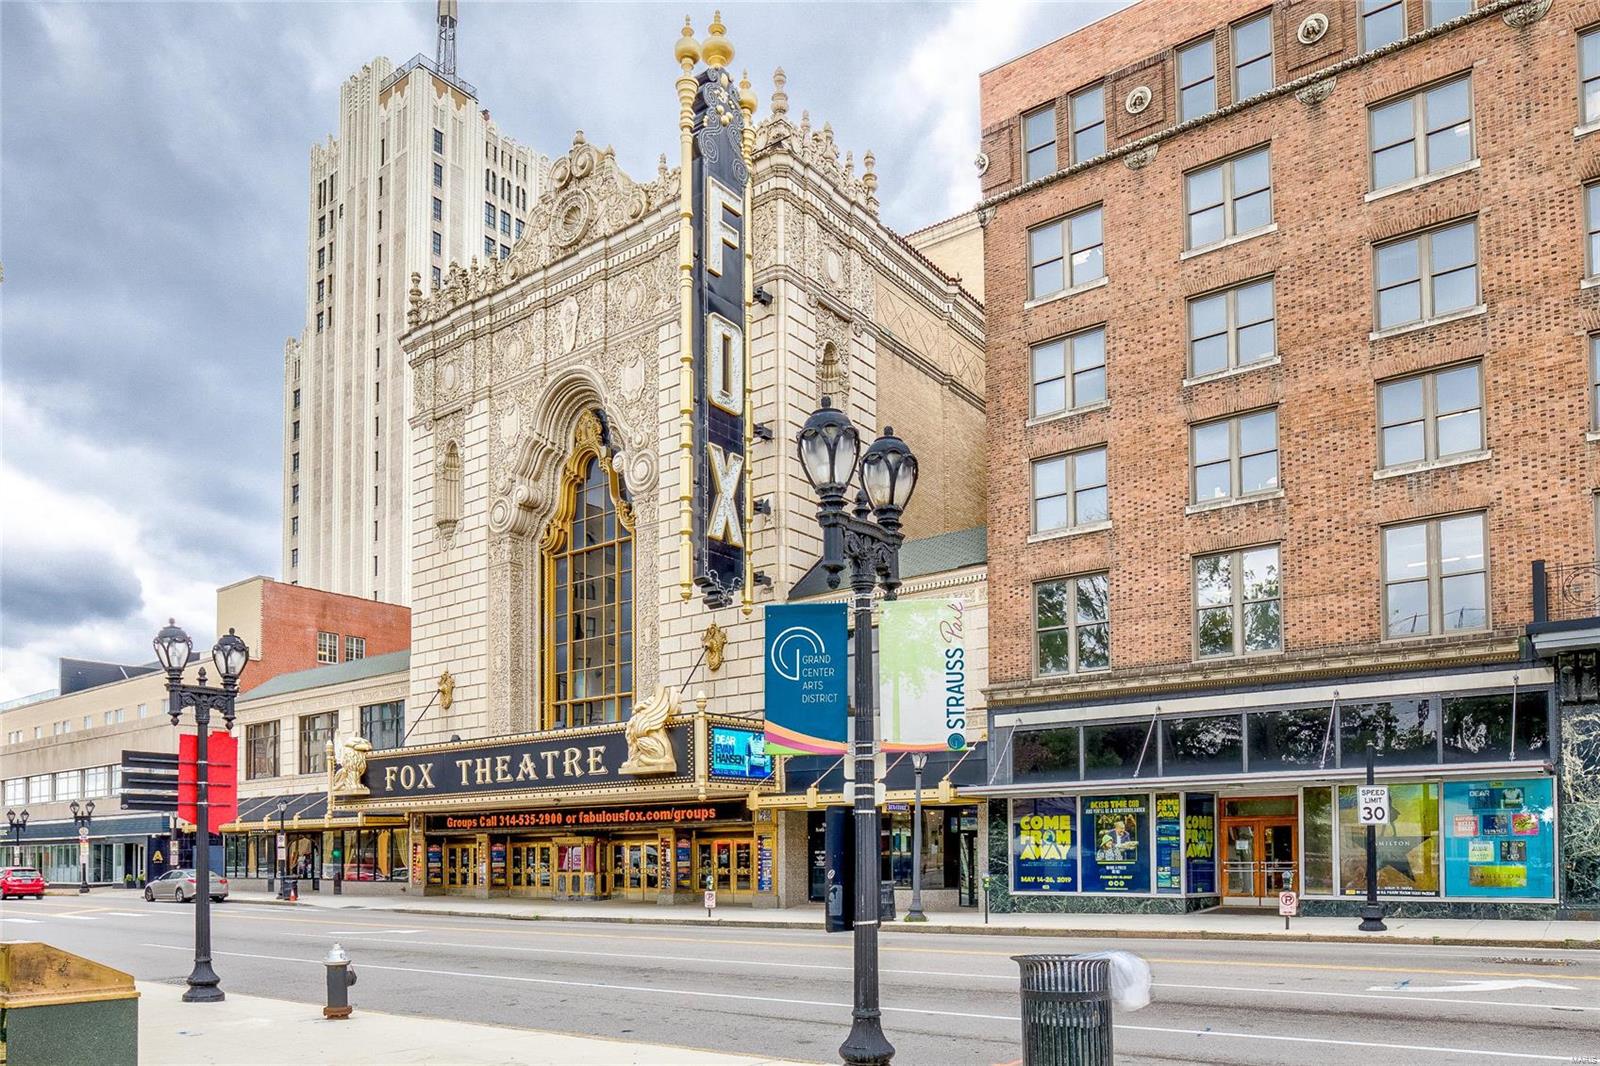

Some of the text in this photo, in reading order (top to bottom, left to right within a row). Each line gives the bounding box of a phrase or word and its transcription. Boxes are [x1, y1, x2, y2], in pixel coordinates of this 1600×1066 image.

[706, 175, 743, 548] FOX
[940, 602, 964, 643] Park
[802, 654, 831, 664] GRAND
[802, 667, 835, 677] CENTER
[802, 680, 824, 690] ARTS
[945, 647, 966, 729] STRAUSS
[801, 693, 838, 703] DISTRICT
[714, 734, 736, 744] DEAR
[715, 744, 735, 753] EVAN
[715, 753, 745, 764] HANSEN
[384, 745, 608, 792] FOX THEATRE
[447, 807, 716, 829] Groups Call 314-535-2900 or fabulousfox.com/groups
[1362, 806, 1386, 821] 30
[1020, 815, 1070, 830] COME
[1186, 815, 1213, 829] COME
[1020, 830, 1071, 845] FROM
[1186, 829, 1213, 843] FROM
[1020, 844, 1071, 860] AWAY
[1186, 843, 1213, 858] AWAY
